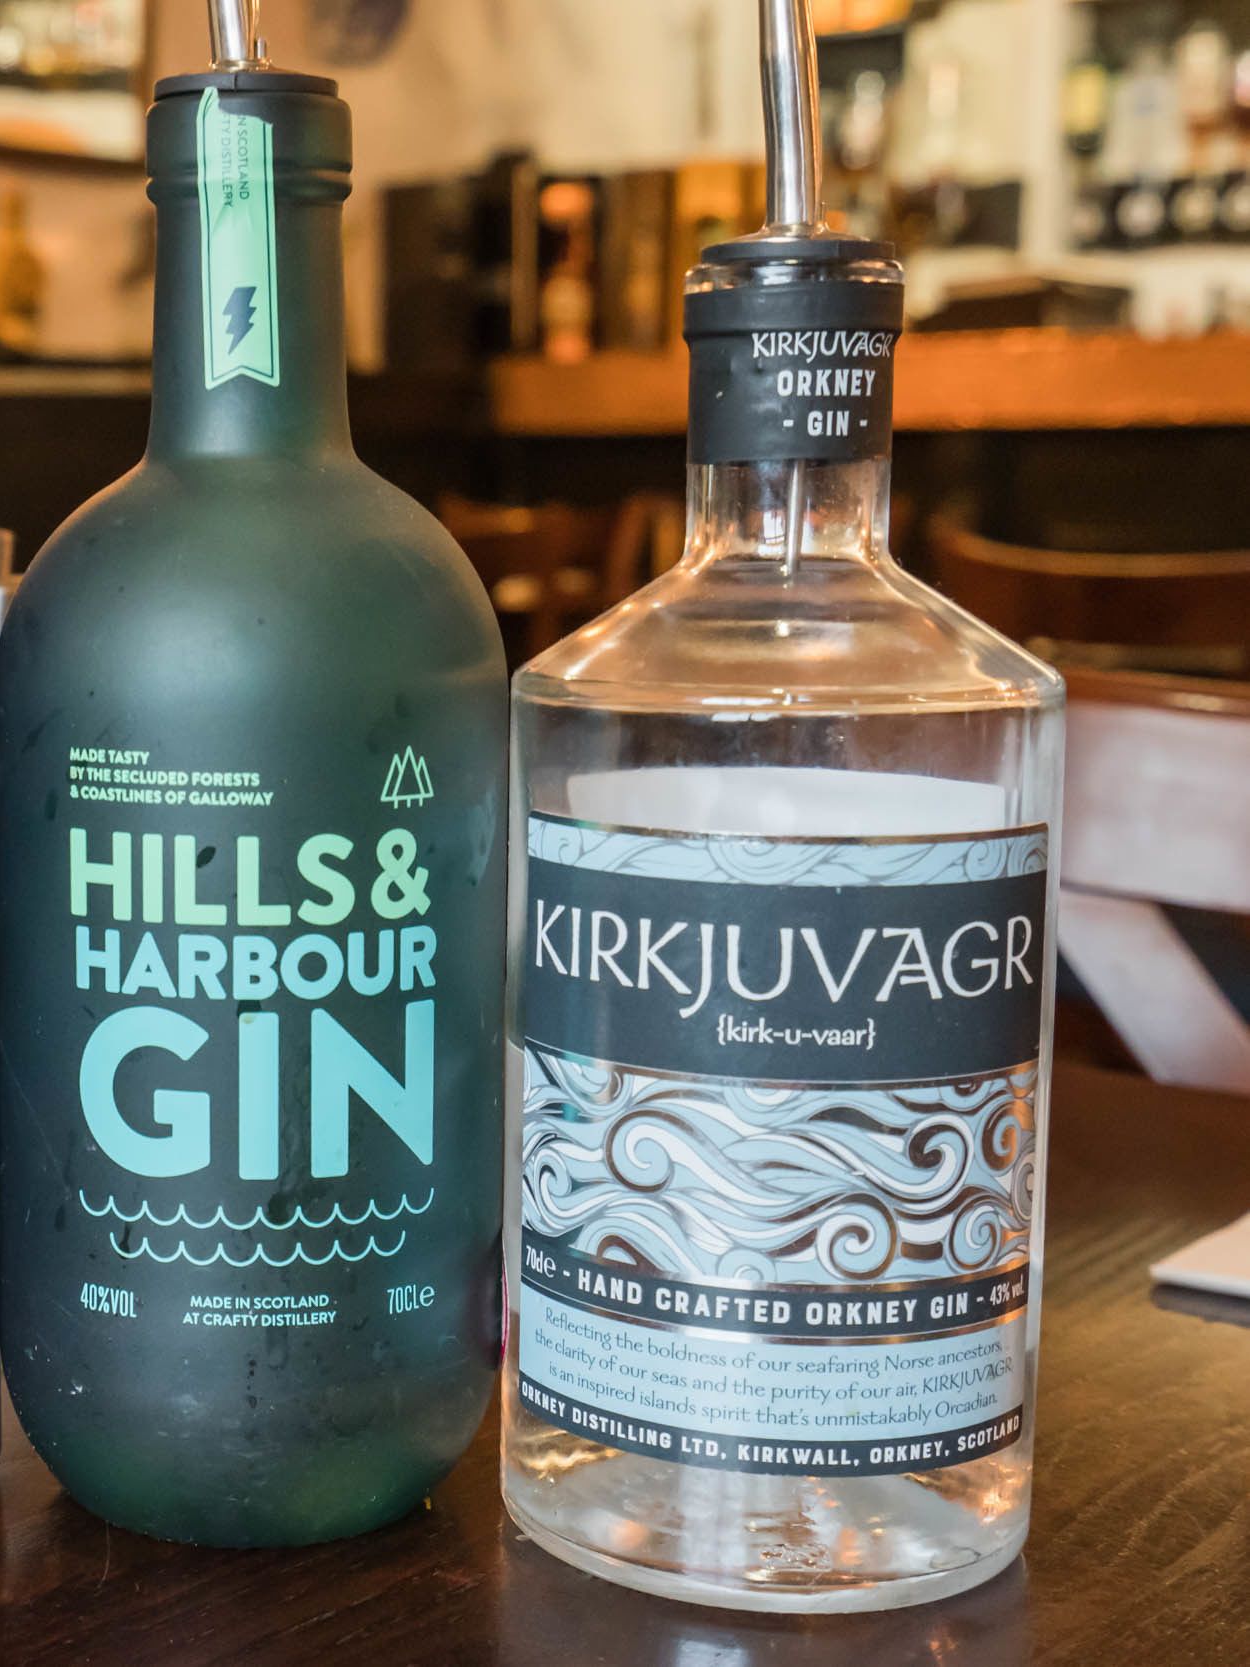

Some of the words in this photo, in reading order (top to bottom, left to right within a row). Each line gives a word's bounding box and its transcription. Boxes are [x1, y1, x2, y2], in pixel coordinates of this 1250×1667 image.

[221, 139, 233, 207] DISTILLERY
[237, 128, 250, 200] SCOTLAND
[777, 368, 877, 397] ORKNEY
[807, 410, 850, 437] GIN
[70, 747, 106, 763] MADE
[108, 750, 150, 766] TASTY
[70, 766, 85, 780] BY
[86, 768, 112, 782] THE
[113, 769, 189, 785] SECLUDED
[191, 772, 260, 787] FORESTS
[70, 785, 79, 798] &
[80, 786, 162, 804] COASTLINES
[164, 790, 186, 805] OF
[188, 791, 274, 806] GALLOWAY
[69, 827, 356, 926] HILLS
[370, 828, 432, 920] &
[75, 925, 438, 1001] HARBOUR
[717, 1014, 877, 1051] {kirk-u-vaar}
[79, 999, 435, 1181] GIN
[182, 1311, 200, 1326] AT
[202, 1312, 260, 1327] CRAFTY
[261, 1311, 337, 1327] DISTILLERY
[190, 1295, 232, 1309] MADE
[235, 1296, 251, 1310] IN
[253, 1295, 330, 1309] SCOTLAND
[578, 1268, 643, 1305] HAND
[655, 1287, 791, 1324] CRAFTED
[805, 1299, 918, 1326] ORKNEY
[930, 1292, 969, 1319] GIN
[989, 1282, 1011, 1306] 43%
[535, 1328, 553, 1350] the
[554, 1338, 596, 1369] clarity
[599, 1355, 618, 1372] of
[619, 1363, 648, 1379] our
[652, 1371, 687, 1388] seas
[692, 1375, 727, 1394] and
[732, 1377, 766, 1397] the
[771, 1385, 831, 1405] purity
[835, 1381, 860, 1400] of
[861, 1385, 894, 1399] our
[895, 1381, 918, 1398] air,
[545, 1307, 612, 1351] Reflecting
[615, 1331, 643, 1353] the
[648, 1337, 727, 1367] boldness
[732, 1352, 756, 1369] of
[758, 1359, 793, 1373] our
[796, 1355, 880, 1380] seafaring
[884, 1354, 935, 1373] Norse
[521, 1381, 567, 1418] ORKNEY
[572, 1407, 672, 1449] DISTILLING
[681, 1436, 727, 1461] LTD,
[737, 1443, 860, 1467] KIRKWALL,
[869, 1440, 950, 1464] ORKNEY,
[957, 1415, 1020, 1452] SCOTLAND
[549, 1361, 557, 1377] is
[559, 1369, 575, 1384] an
[577, 1373, 636, 1402] inspired
[639, 1391, 697, 1416] islands
[702, 1405, 751, 1424] spirit
[815, 1403, 932, 1427] unmistakably
